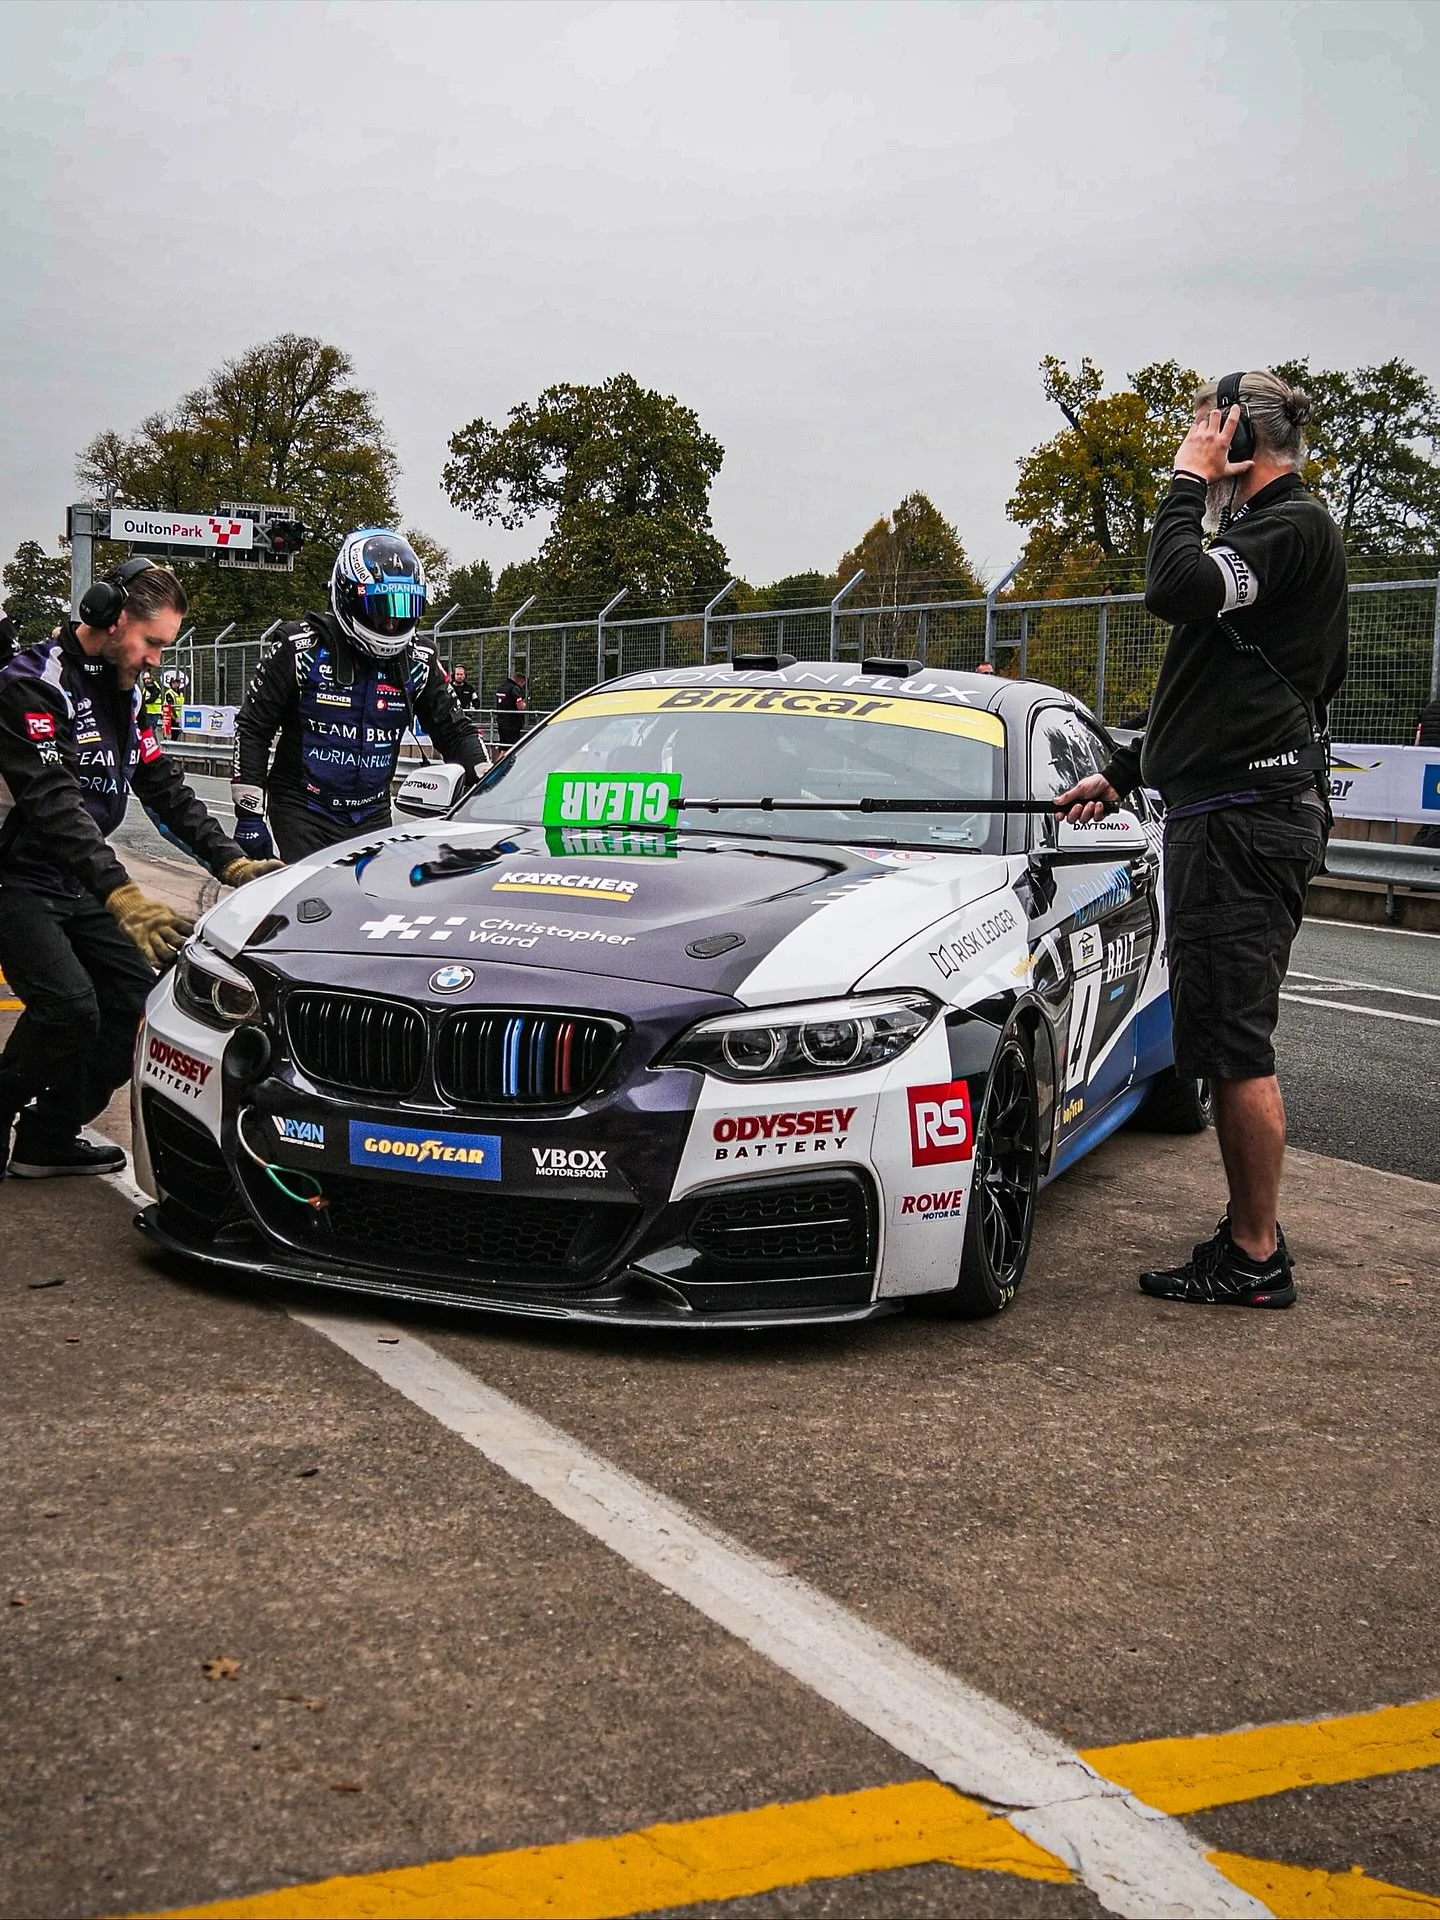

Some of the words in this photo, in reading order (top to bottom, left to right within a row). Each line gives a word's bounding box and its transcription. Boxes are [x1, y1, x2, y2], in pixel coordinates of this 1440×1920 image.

[124, 520, 203, 538] OultonPark
[84, 664, 103, 672] BRIT
[658, 688, 895, 716] Britcar
[28, 719, 52, 735] RS
[308, 718, 357, 739] TEAM
[77, 750, 116, 766] EAM
[560, 781, 670, 823] CLEAR
[1073, 822, 1121, 831] DAYTONA
[467, 930, 540, 949] Ward
[479, 918, 636, 947] Christopher
[951, 930, 985, 963] RISK
[976, 909, 1018, 945] LEDGER
[1107, 932, 1136, 983] BRIT
[149, 1037, 214, 1086] ODYSSEY
[146, 1061, 203, 1099] BATTERY
[285, 1118, 324, 1143] RYAN
[713, 1106, 858, 1143] ODYSSEY
[915, 1098, 967, 1150] RS
[531, 1147, 607, 1170] VBOX
[715, 1137, 848, 1160] BATTERY
[535, 1167, 609, 1178] MOTORSPORT
[901, 1190, 963, 1214] ROWE
[922, 1211, 949, 1221] MOTOR
[950, 1210, 961, 1218] OIL
